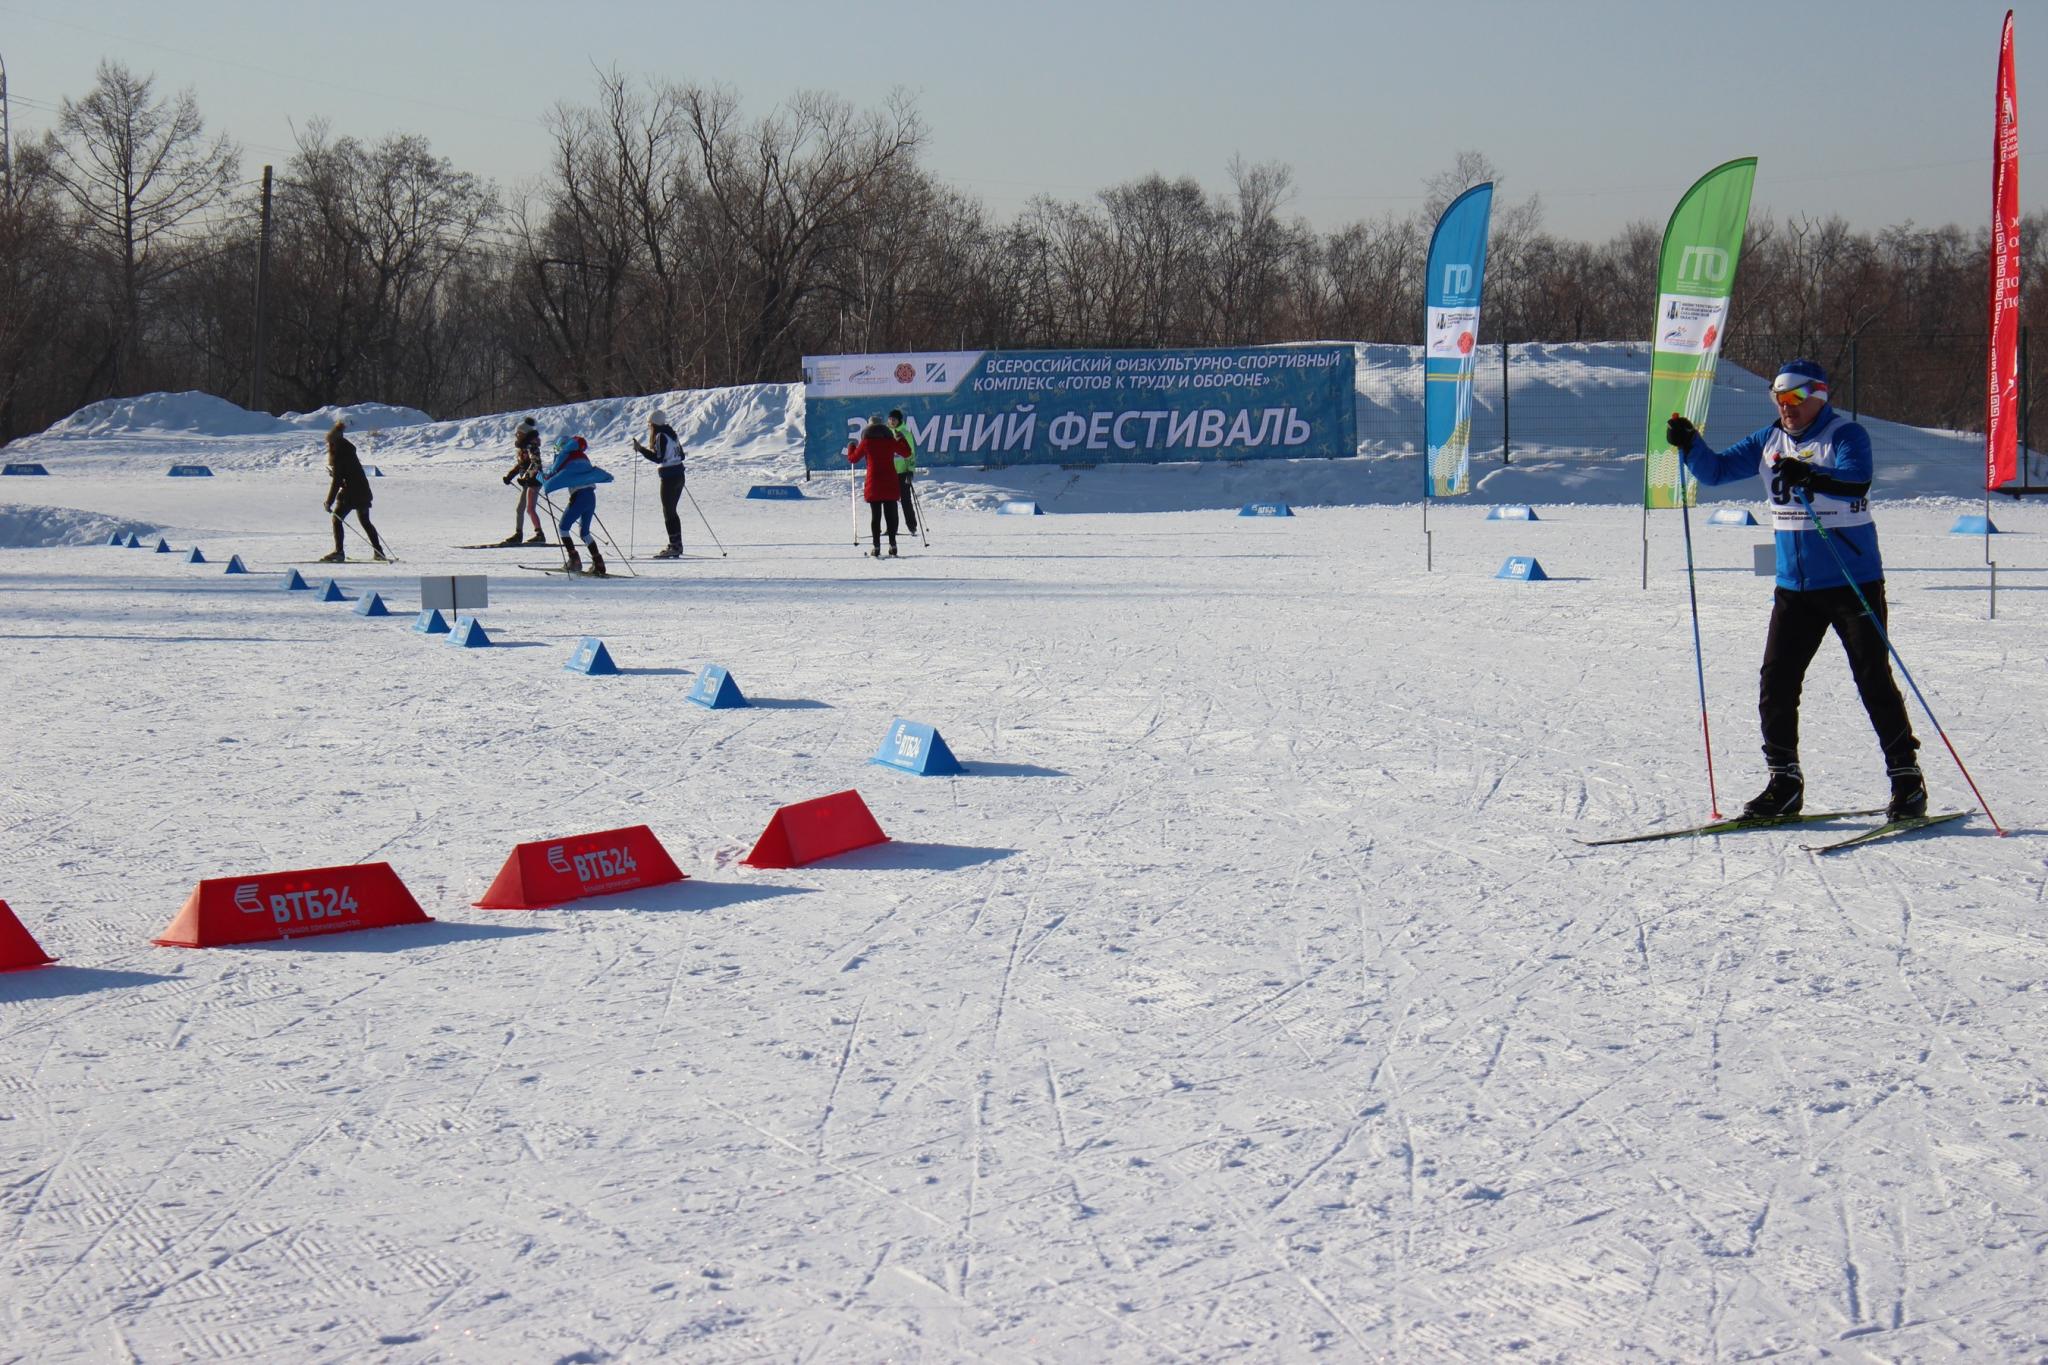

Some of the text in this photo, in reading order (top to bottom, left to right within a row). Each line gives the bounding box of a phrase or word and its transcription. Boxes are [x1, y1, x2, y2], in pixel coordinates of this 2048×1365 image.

[986, 350, 1341, 374] ВСЕРОССИЙСКИЙ ФИЗКУЛЬТУРНО-СПОРТИВНЫЙ
[973, 372, 1271, 391] КОМПЛЕКС «ГОТОВ К ТРУДУ И ОБОРОНЕ»
[842, 404, 1311, 456] ЗМНИЙ ФЕСТИВАЛЬ
[572, 846, 637, 882] ВТБ24
[269, 886, 359, 923] ВТБ24
